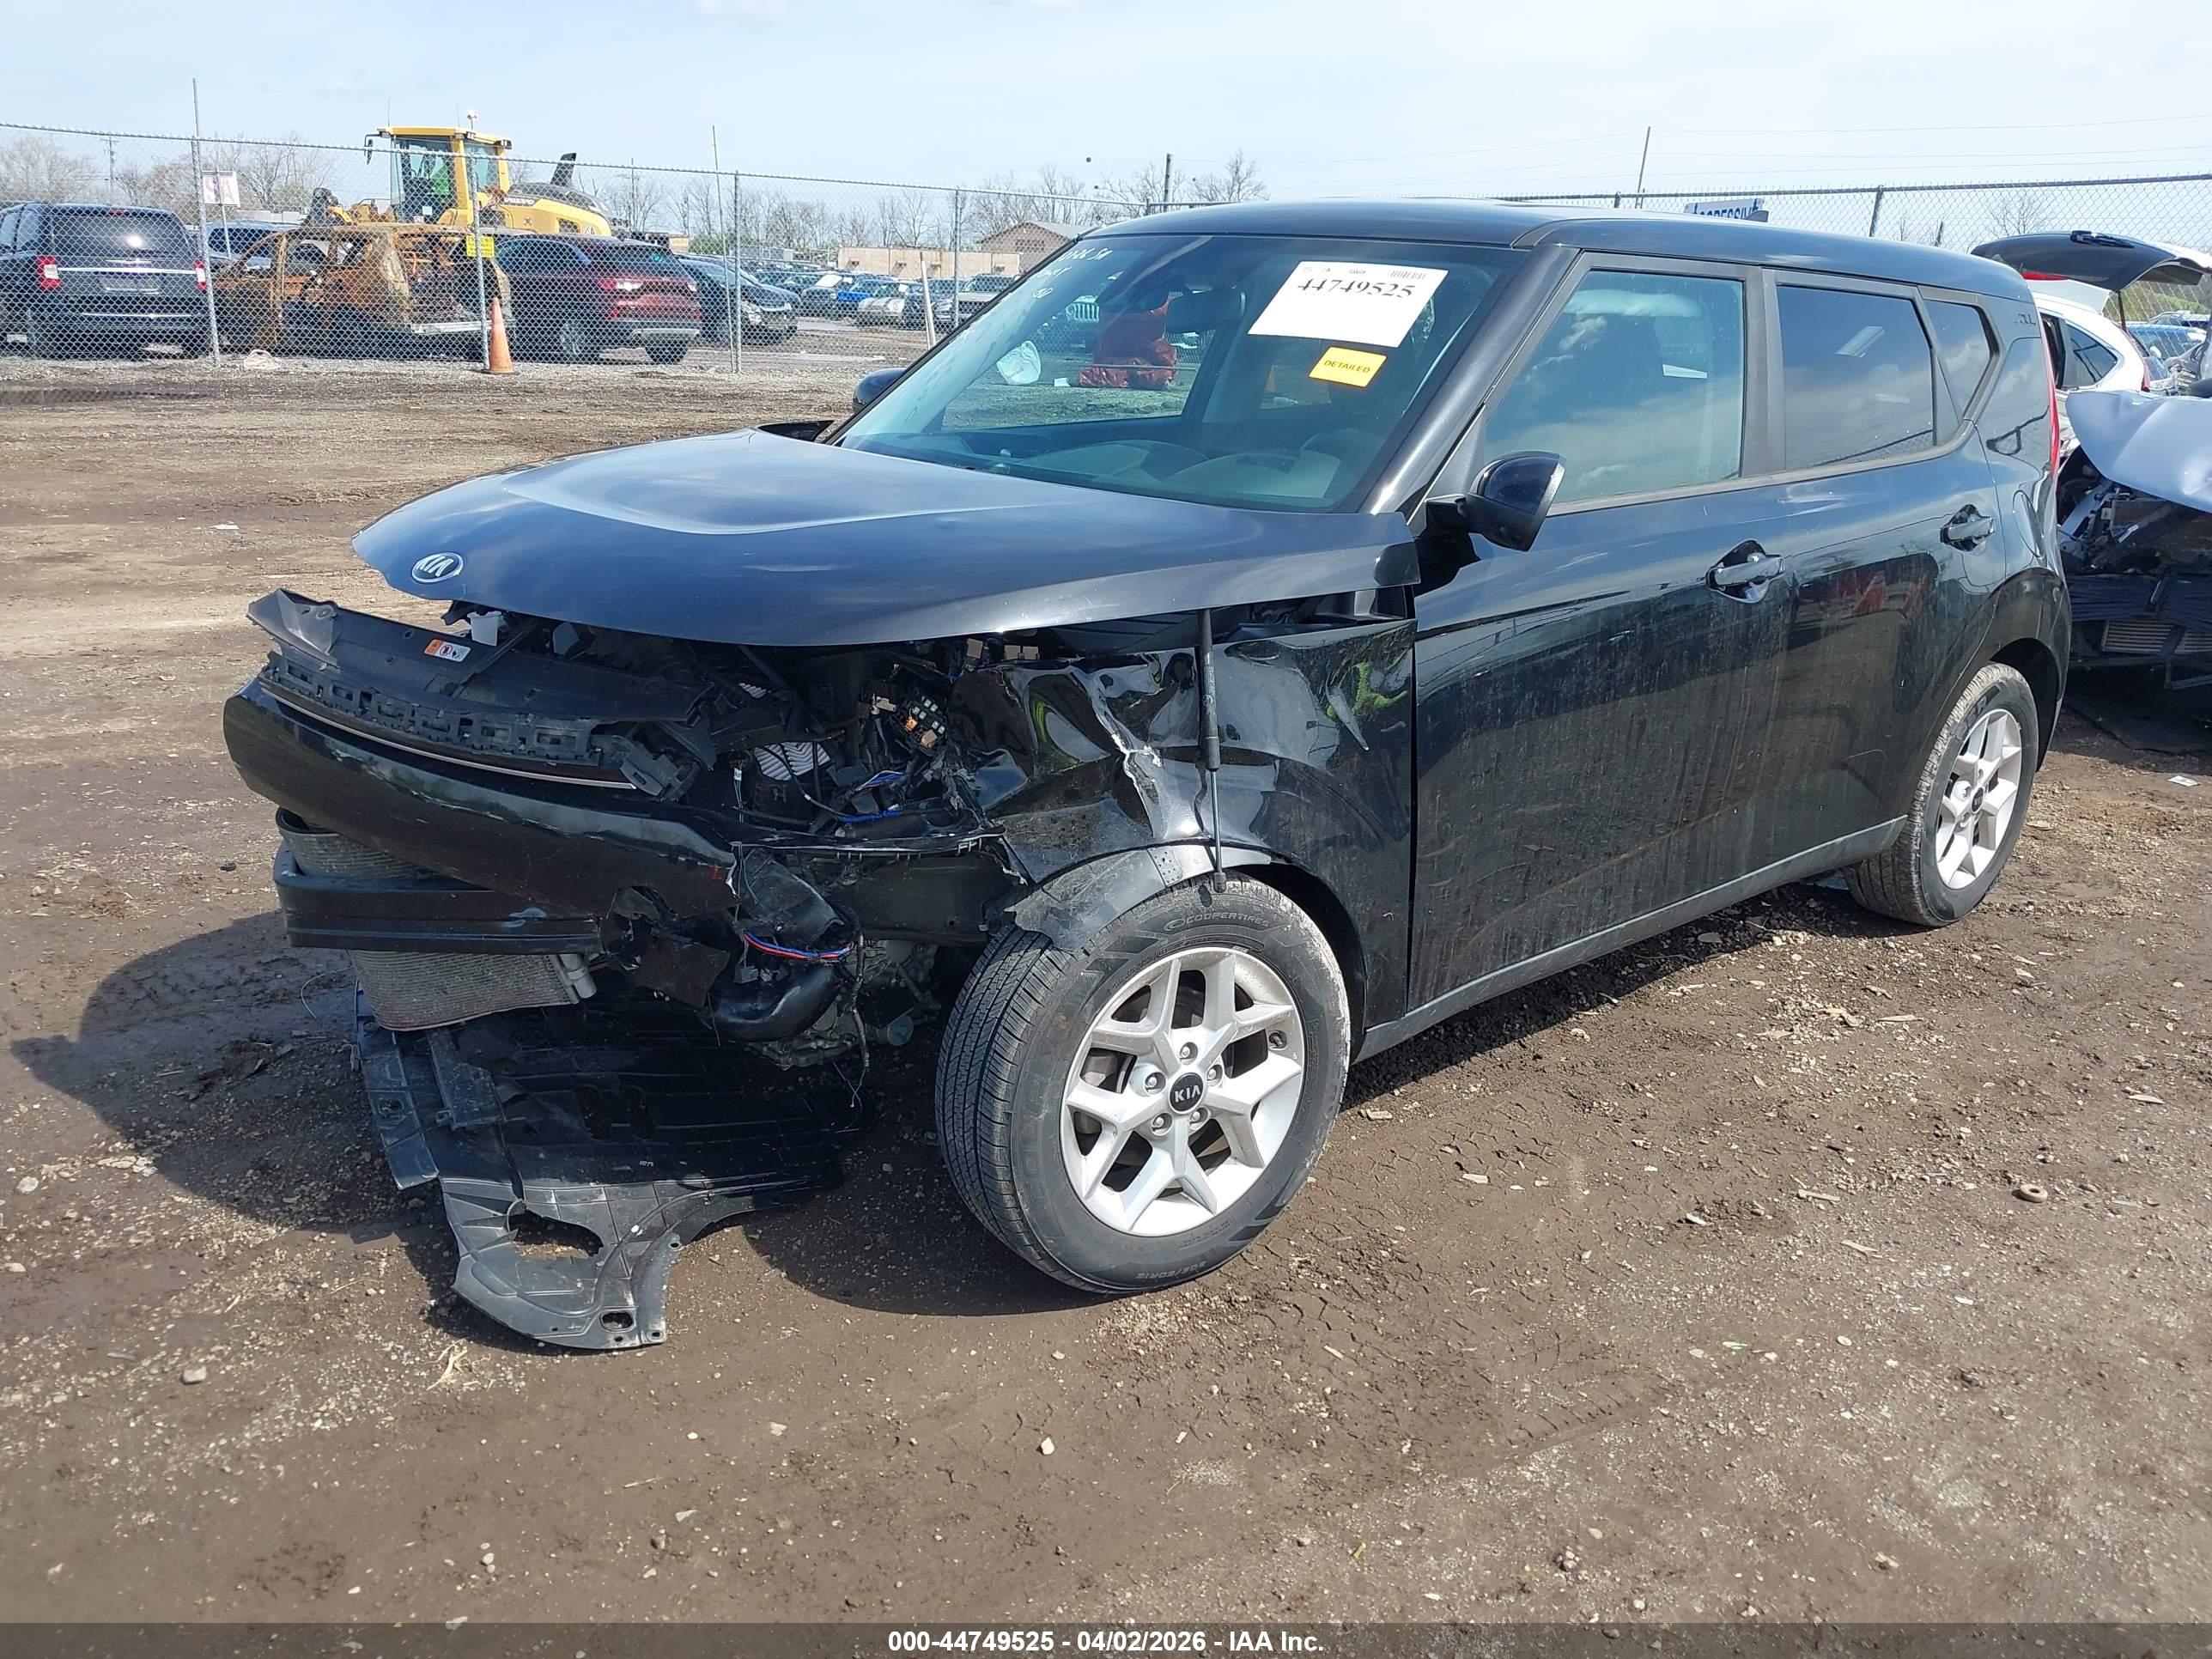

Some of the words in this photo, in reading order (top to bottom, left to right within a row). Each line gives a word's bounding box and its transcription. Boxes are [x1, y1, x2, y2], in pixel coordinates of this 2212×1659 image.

[1297, 277, 1416, 298] 44749525
[1323, 359, 1371, 374] DETAILED
[416, 555, 454, 577] KIA
[1174, 1085, 1201, 1103] KIA
